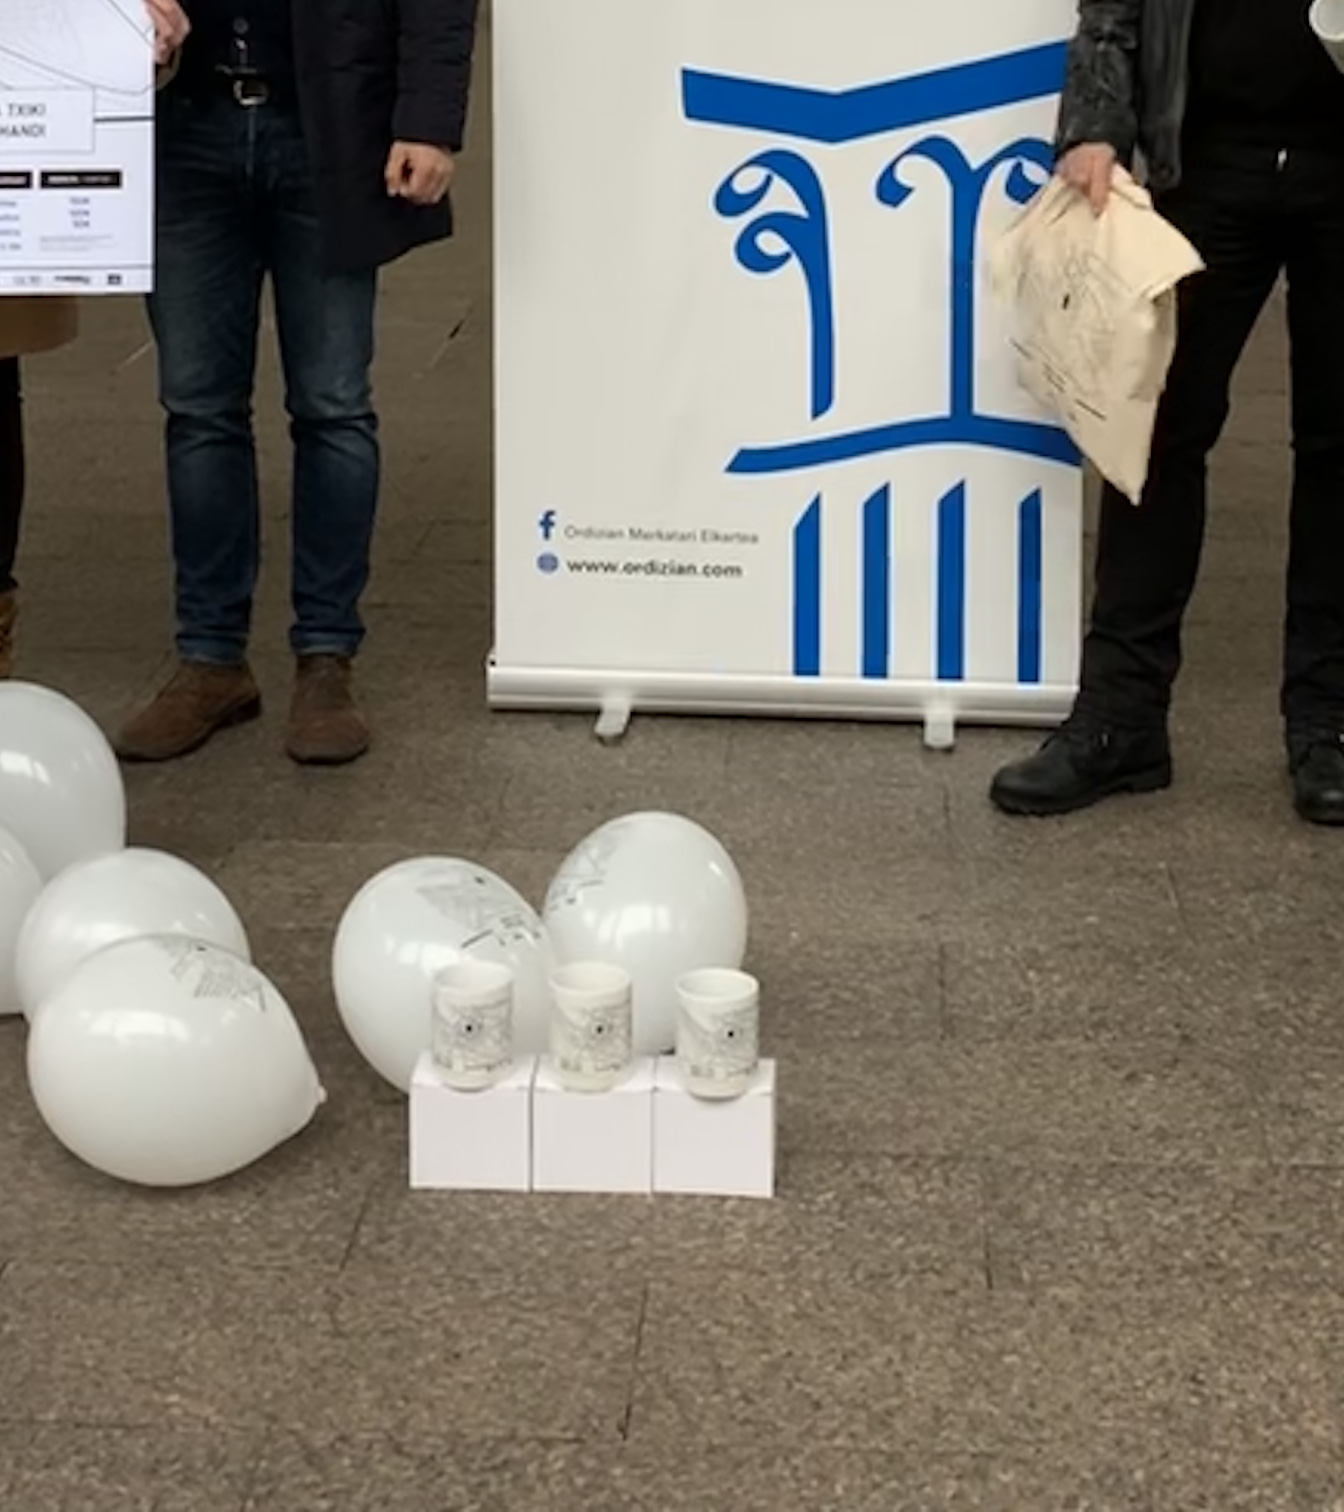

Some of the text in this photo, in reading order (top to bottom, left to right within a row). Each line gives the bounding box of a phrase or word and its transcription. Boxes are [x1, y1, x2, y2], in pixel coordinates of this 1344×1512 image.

[563, 524, 625, 540] Ordizian
[628, 526, 697, 543] Merkatari
[700, 529, 760, 545] Elkartea
[565, 559, 744, 578] www.ordizian.com
